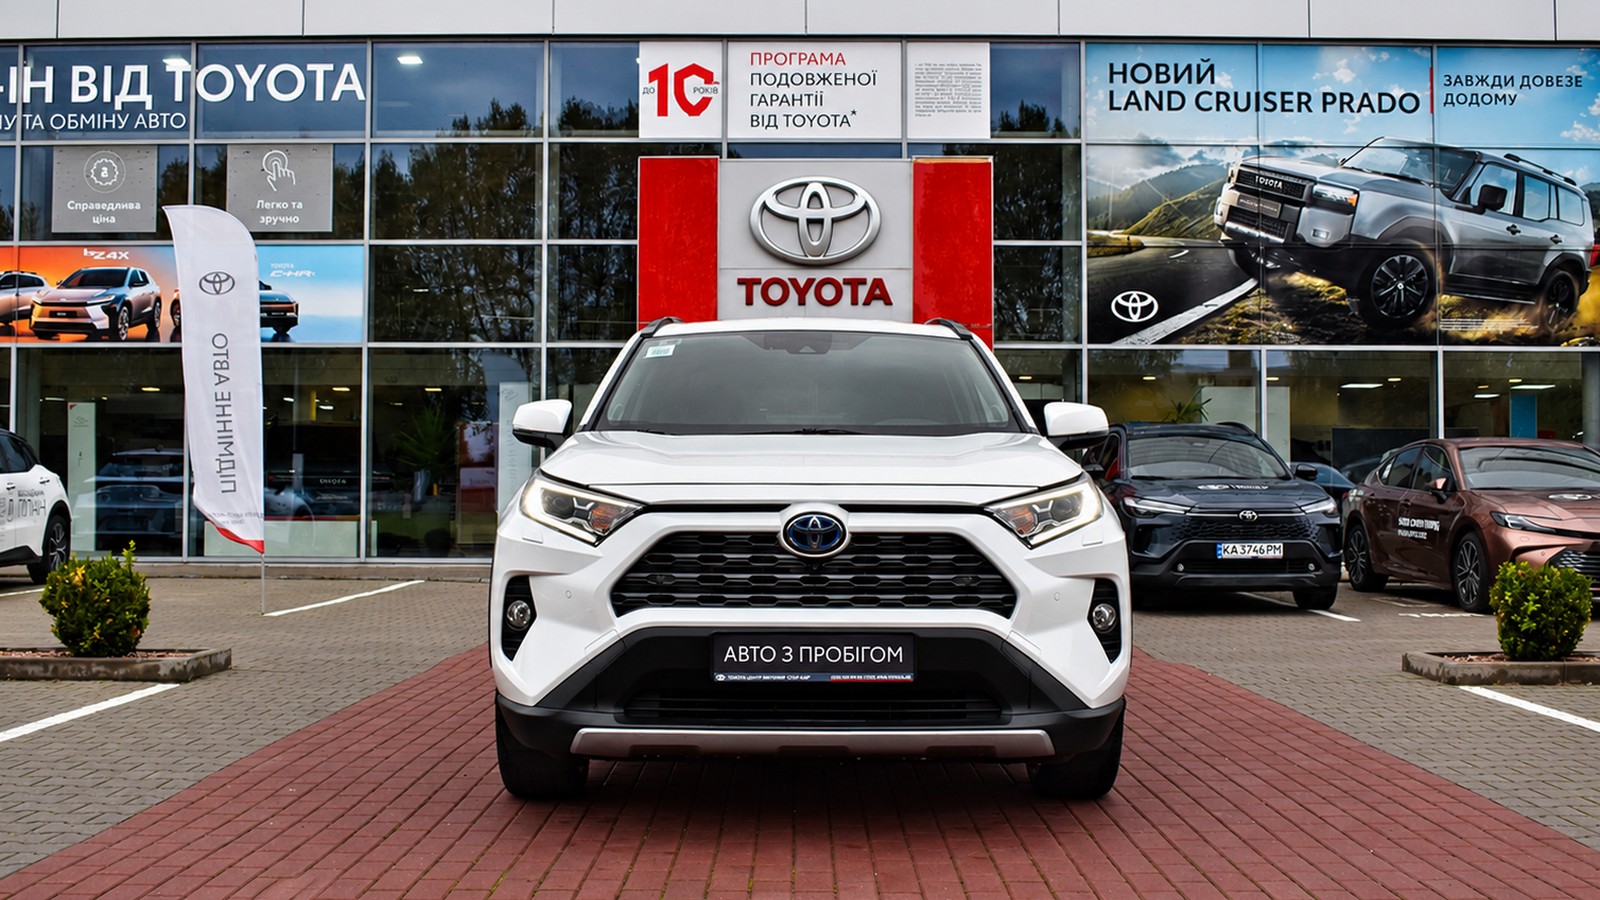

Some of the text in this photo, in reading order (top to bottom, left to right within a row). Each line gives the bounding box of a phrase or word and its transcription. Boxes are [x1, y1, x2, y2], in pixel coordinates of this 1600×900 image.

[750, 52, 846, 66] ПРОГРАМА
[750, 69, 878, 88] ПОДОВЖЕНОЇ
[1109, 58, 1216, 85] НОВИЙ
[71, 65, 152, 111] ВІД
[166, 63, 366, 102] TOYOTA
[1443, 74, 1583, 90] ЗАВЖДИ ДОВЕЗЕ
[642, 87, 656, 95] ДО
[693, 86, 719, 95] РОКІВ
[1109, 90, 1421, 114] LAND CRUISER PRADO
[1443, 92, 1518, 107] ДОДОМУ
[23, 114, 45, 129] ТА
[50, 113, 130, 130] ОБМІНУ
[134, 113, 187, 129] АВТО
[750, 114, 778, 130] ВІД
[67, 200, 141, 212] Справедлива
[256, 200, 289, 209] Легко
[92, 214, 116, 224] ціна
[259, 215, 300, 226] зручно
[737, 277, 893, 306] TOYOTA
[723, 645, 903, 663] АВТО З ПРОБІГОМ
